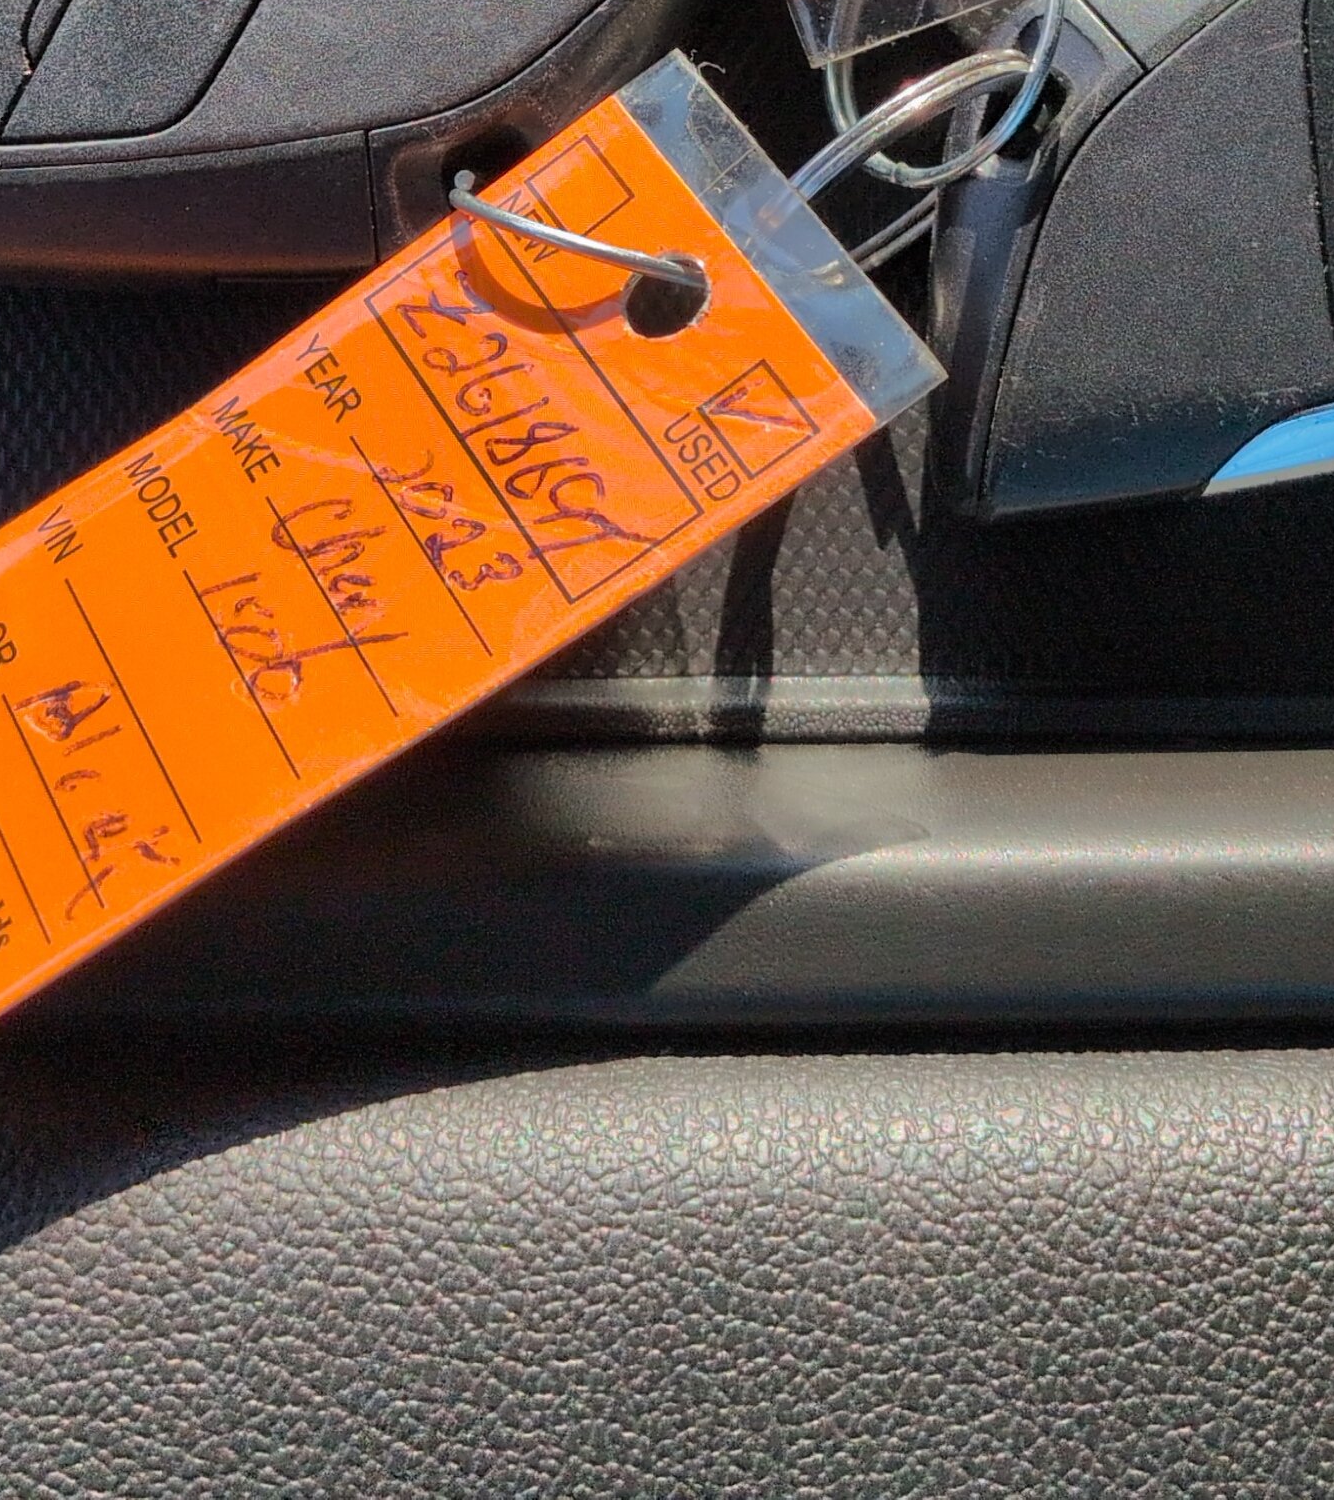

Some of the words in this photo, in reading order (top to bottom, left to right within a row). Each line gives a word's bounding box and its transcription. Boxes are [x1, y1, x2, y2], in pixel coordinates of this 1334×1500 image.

[294, 333, 362, 424] YEAR
[213, 394, 280, 484] MAKE
[662, 411, 742, 502] USED
[37, 504, 85, 565] VIN
[122, 451, 199, 560] MODEL
